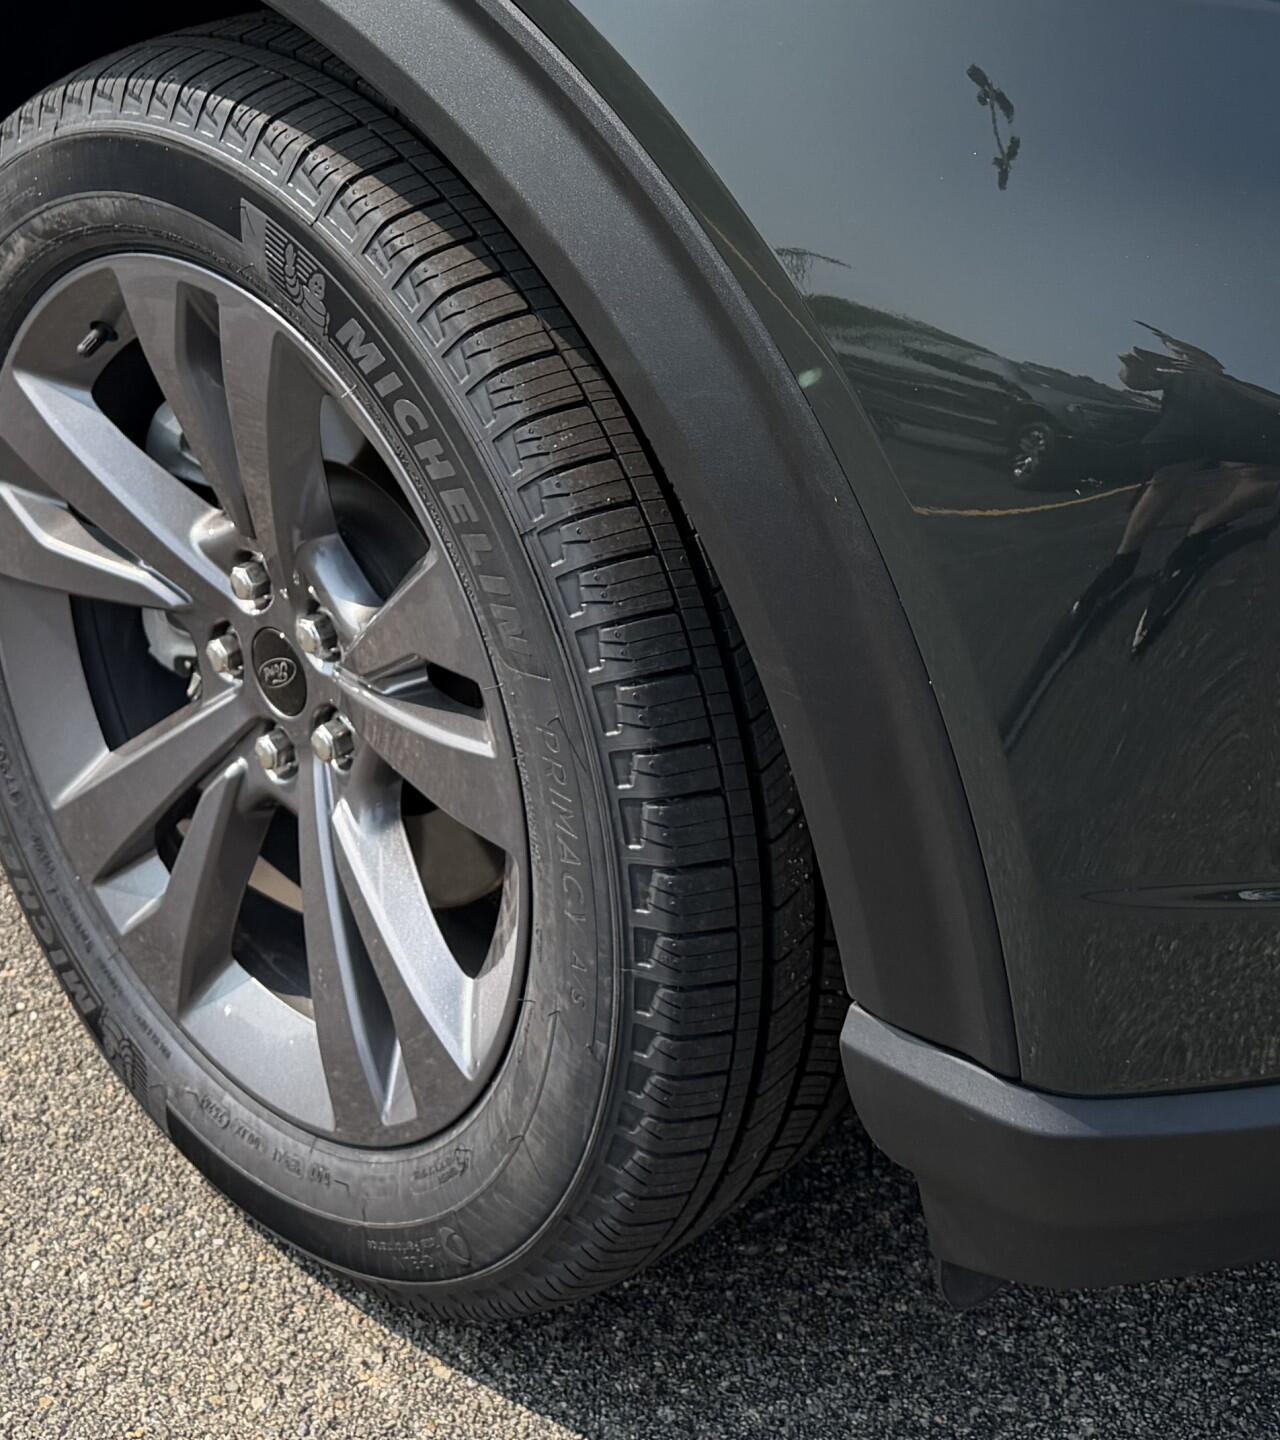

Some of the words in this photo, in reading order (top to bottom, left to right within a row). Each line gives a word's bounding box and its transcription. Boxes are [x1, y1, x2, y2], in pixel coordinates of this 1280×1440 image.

[334, 317, 532, 658] MICHELIN
[535, 723, 588, 928] PRIMACY
[569, 950, 589, 1009] A/S
